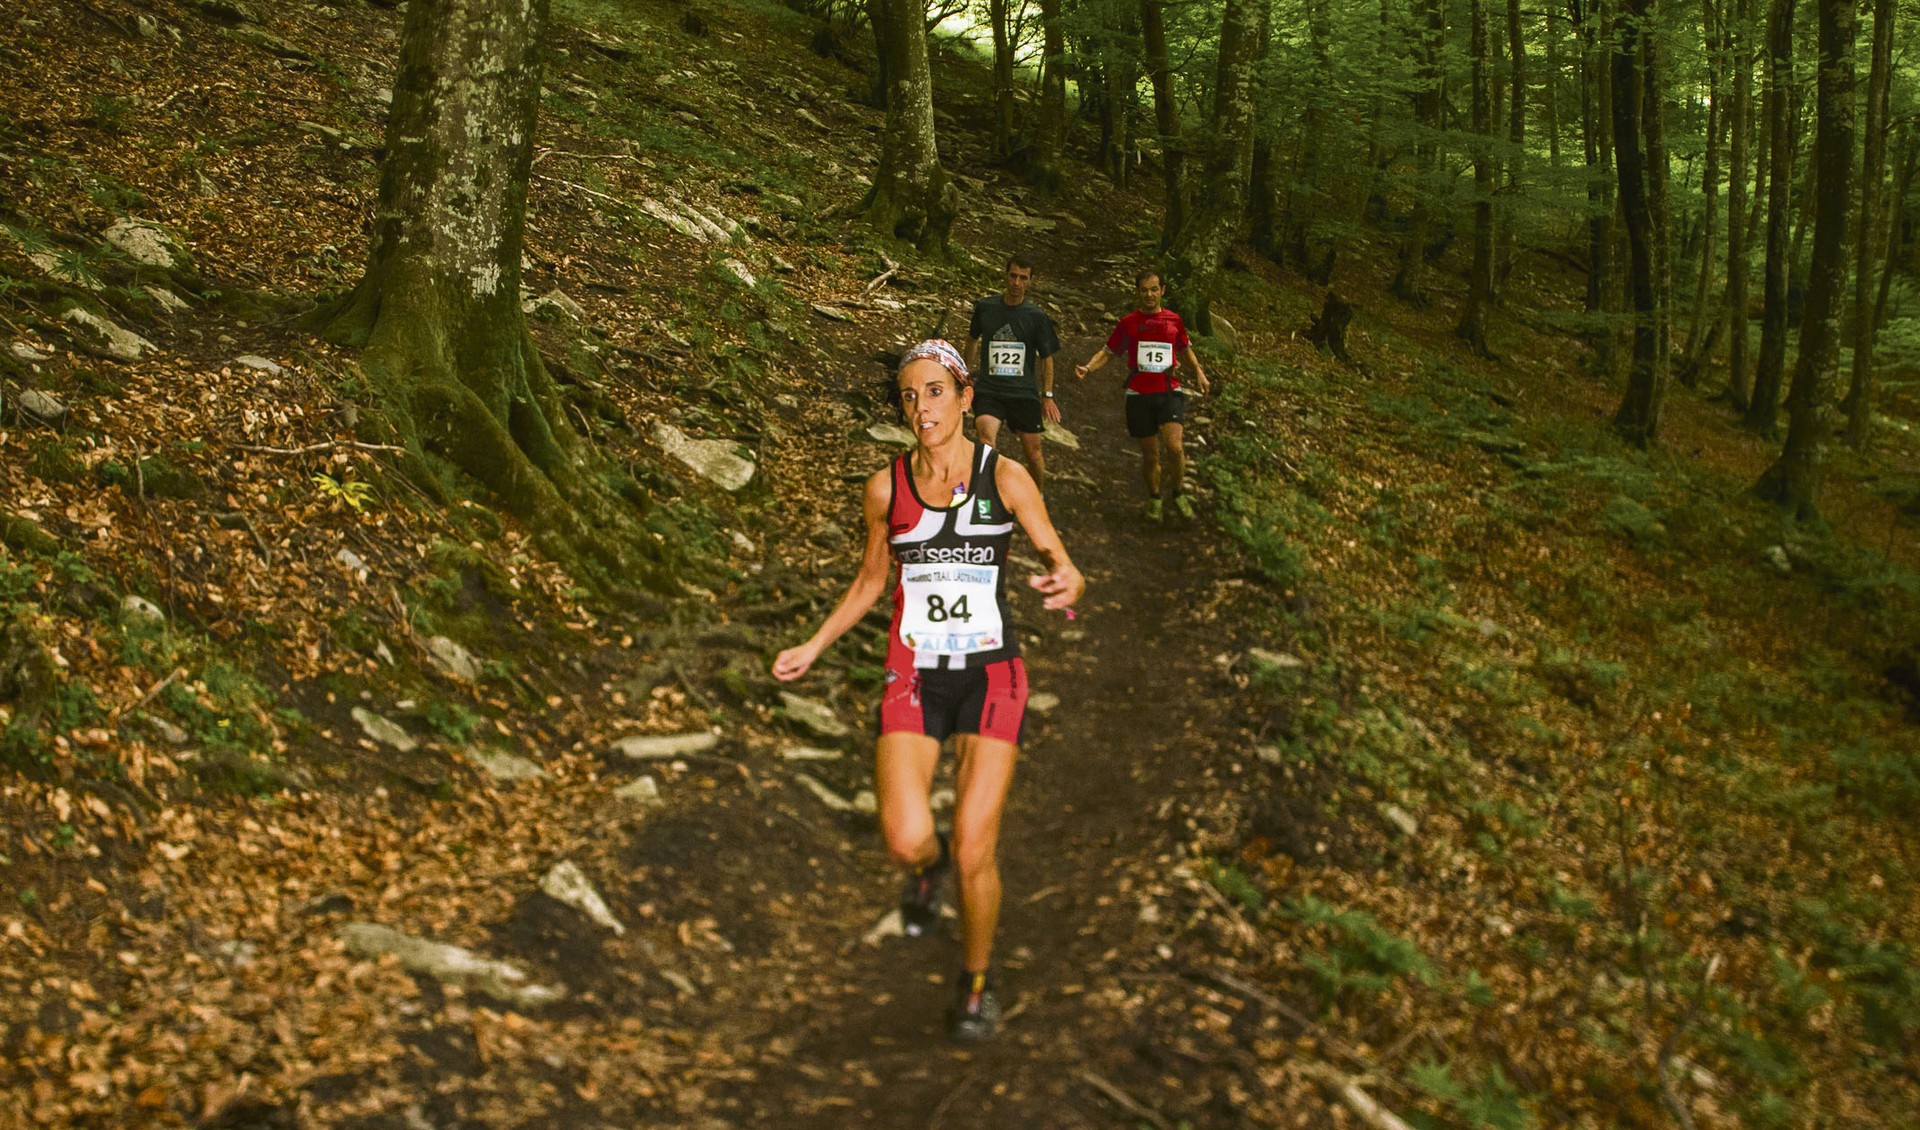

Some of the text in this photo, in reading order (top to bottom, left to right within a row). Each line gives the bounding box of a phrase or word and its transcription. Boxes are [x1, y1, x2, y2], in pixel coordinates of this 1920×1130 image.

[992, 352, 1020, 365] 122
[1146, 351, 1163, 363] 15
[927, 594, 972, 623] 84
